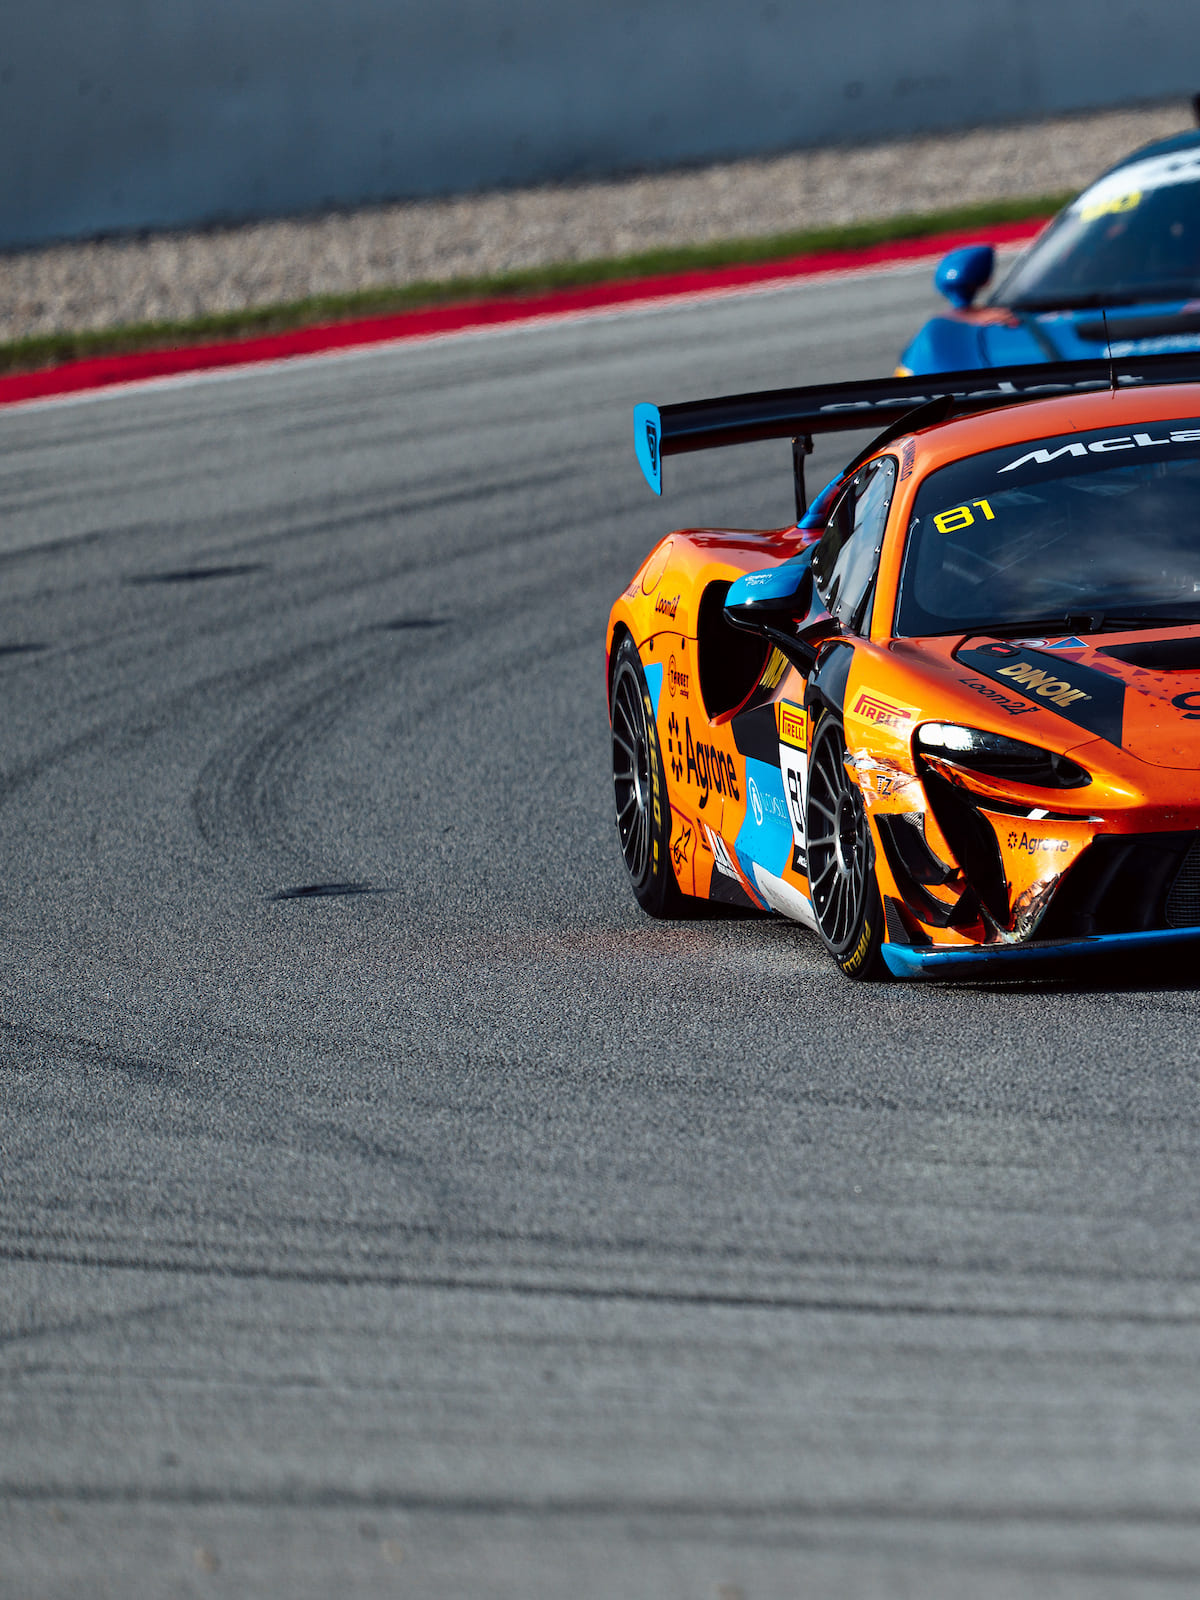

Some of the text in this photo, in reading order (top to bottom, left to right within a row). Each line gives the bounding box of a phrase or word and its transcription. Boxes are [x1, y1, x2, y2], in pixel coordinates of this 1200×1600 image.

[932, 499, 996, 535] 81
[958, 678, 1041, 716] Loom24
[996, 662, 1087, 707] DINOIL
[782, 710, 804, 741] PIRELLI
[685, 717, 740, 810] Agrone
